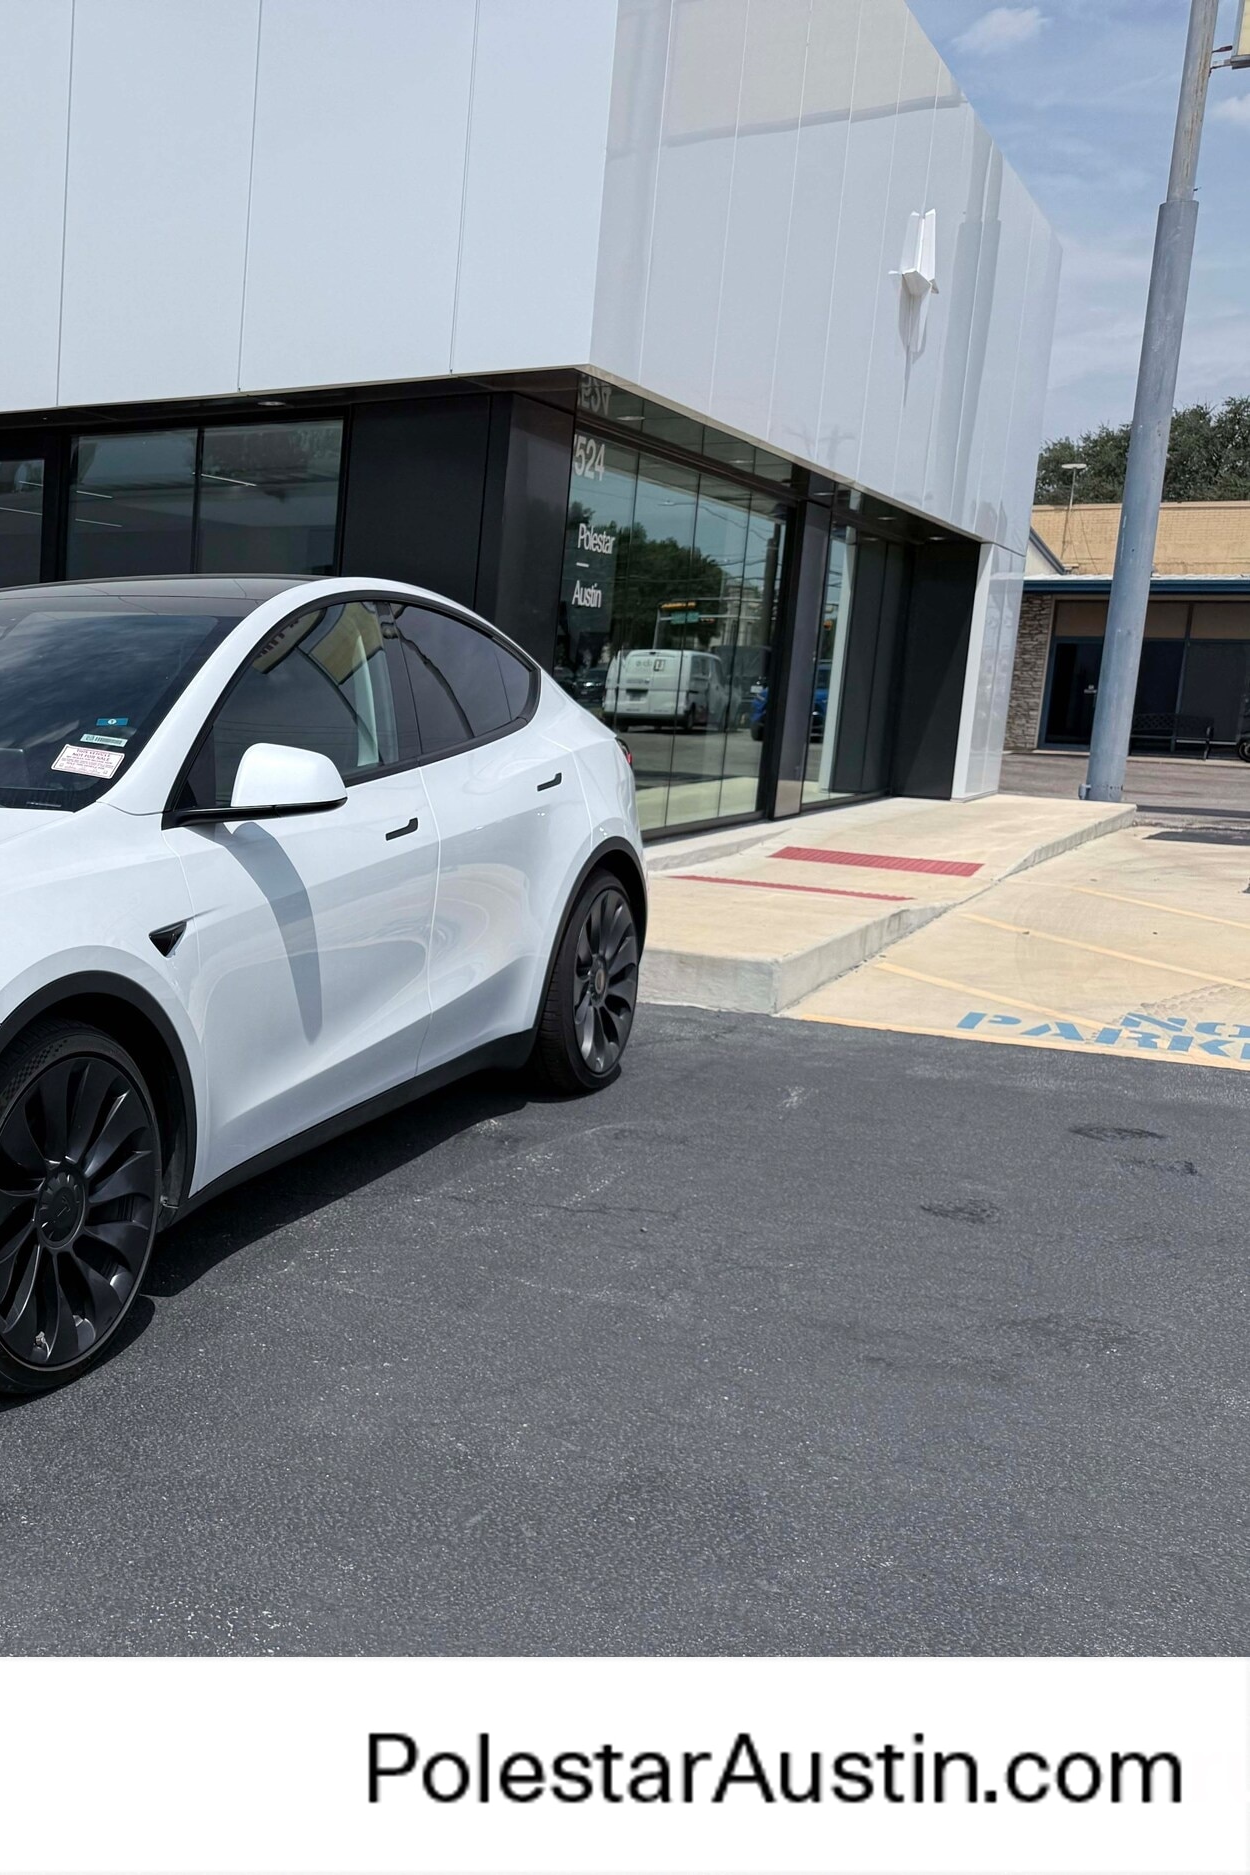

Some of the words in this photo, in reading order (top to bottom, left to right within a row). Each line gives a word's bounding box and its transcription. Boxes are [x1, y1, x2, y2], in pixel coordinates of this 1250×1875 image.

[577, 523, 616, 554] Polestar
[571, 580, 602, 608] Austin
[1120, 1012, 1250, 1038] NO
